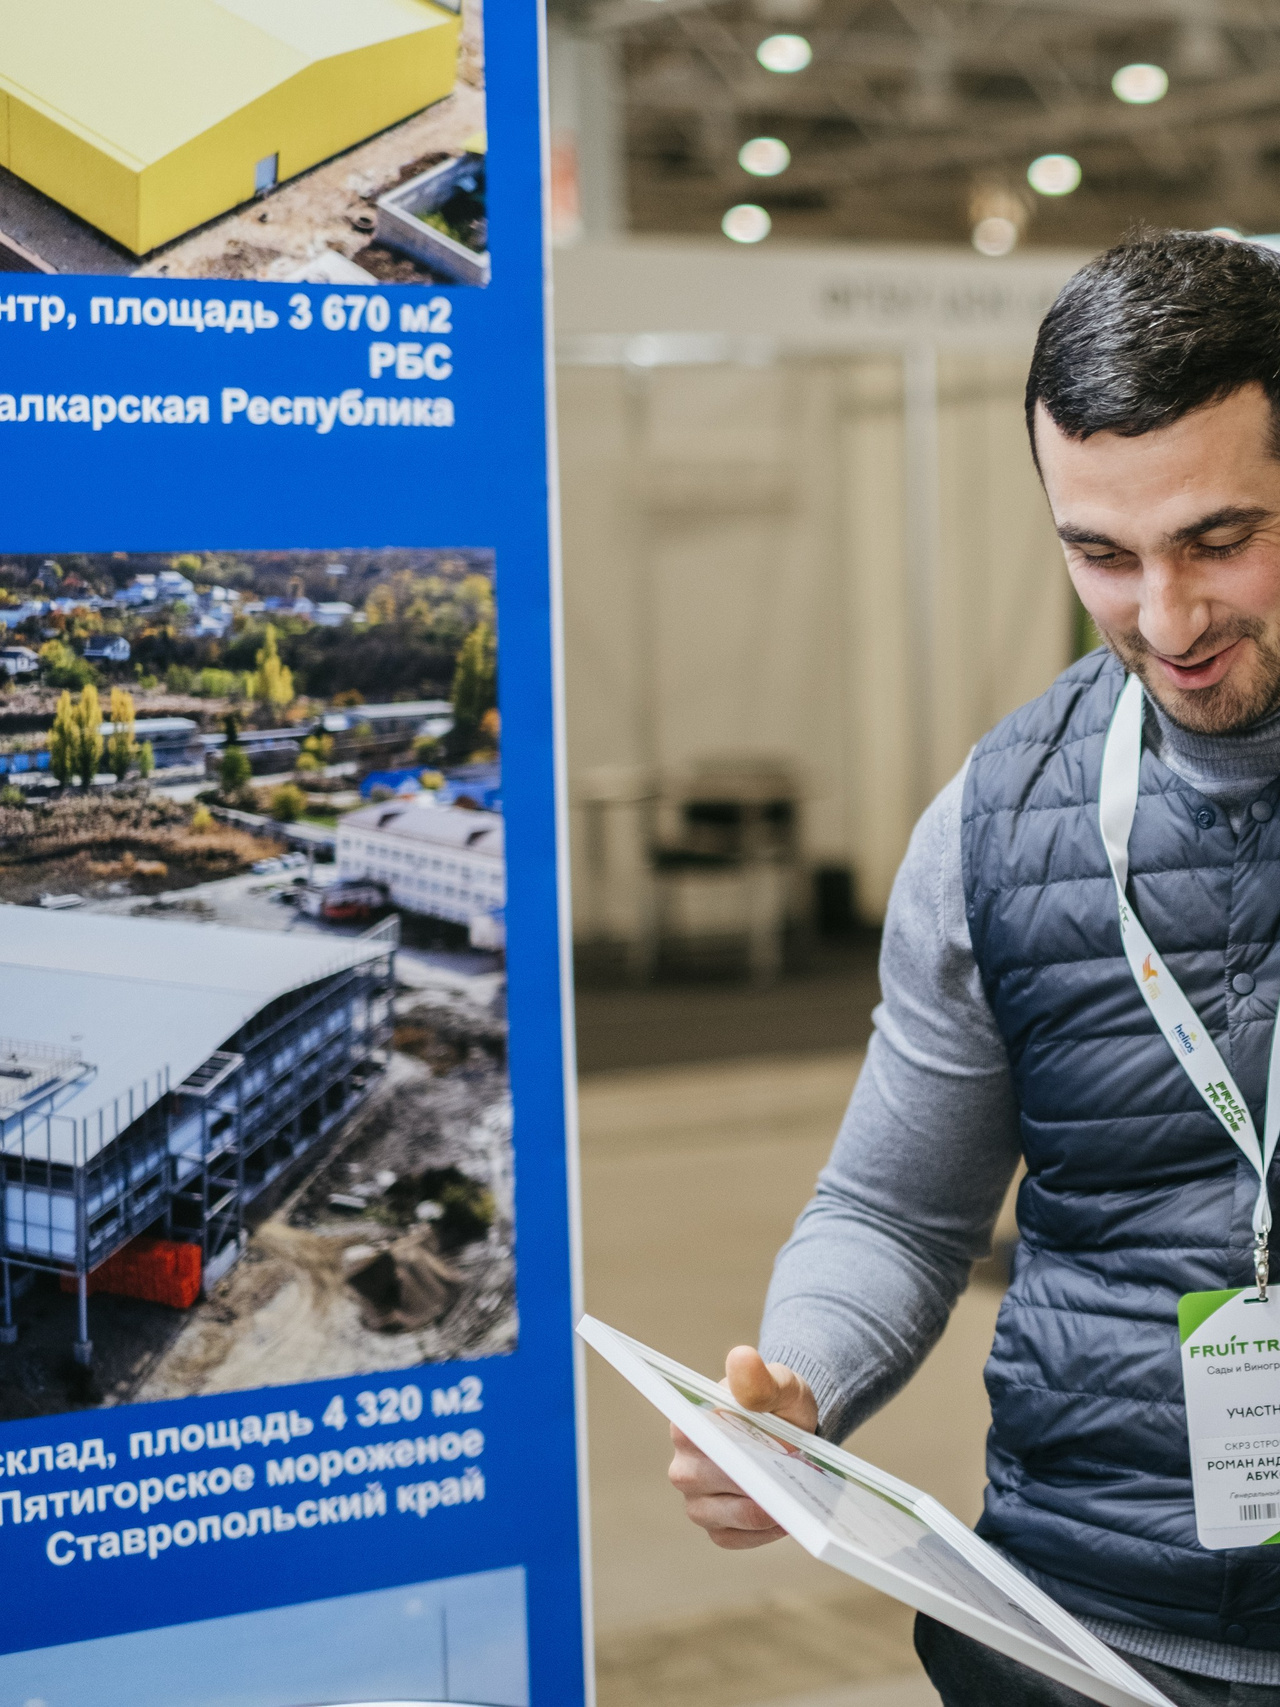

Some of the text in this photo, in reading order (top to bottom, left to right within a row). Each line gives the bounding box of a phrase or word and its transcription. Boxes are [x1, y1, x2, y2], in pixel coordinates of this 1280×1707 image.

[90, 296, 280, 335] площадь
[288, 292, 313, 330] 3
[321, 293, 391, 332] 670
[399, 296, 453, 333] м2
[369, 341, 453, 380] РБС
[221, 387, 455, 434] Республика
[1174, 1023, 1195, 1054] helios
[1203, 1082, 1241, 1133] TRADE
[1215, 1080, 1247, 1124] FRUIT
[1189, 1334, 1249, 1359] FRUIT
[1206, 1365, 1234, 1376] Сады
[1235, 1365, 1242, 1373] и
[0, 1375, 484, 1477] клад, площадь 4 320 м2
[0, 1428, 485, 1526] Пятигорское мороженое
[1207, 1458, 1255, 1471] РОМАН
[46, 1464, 486, 1566] Ставропольский край
[1229, 1490, 1280, 1500] Генеральный
